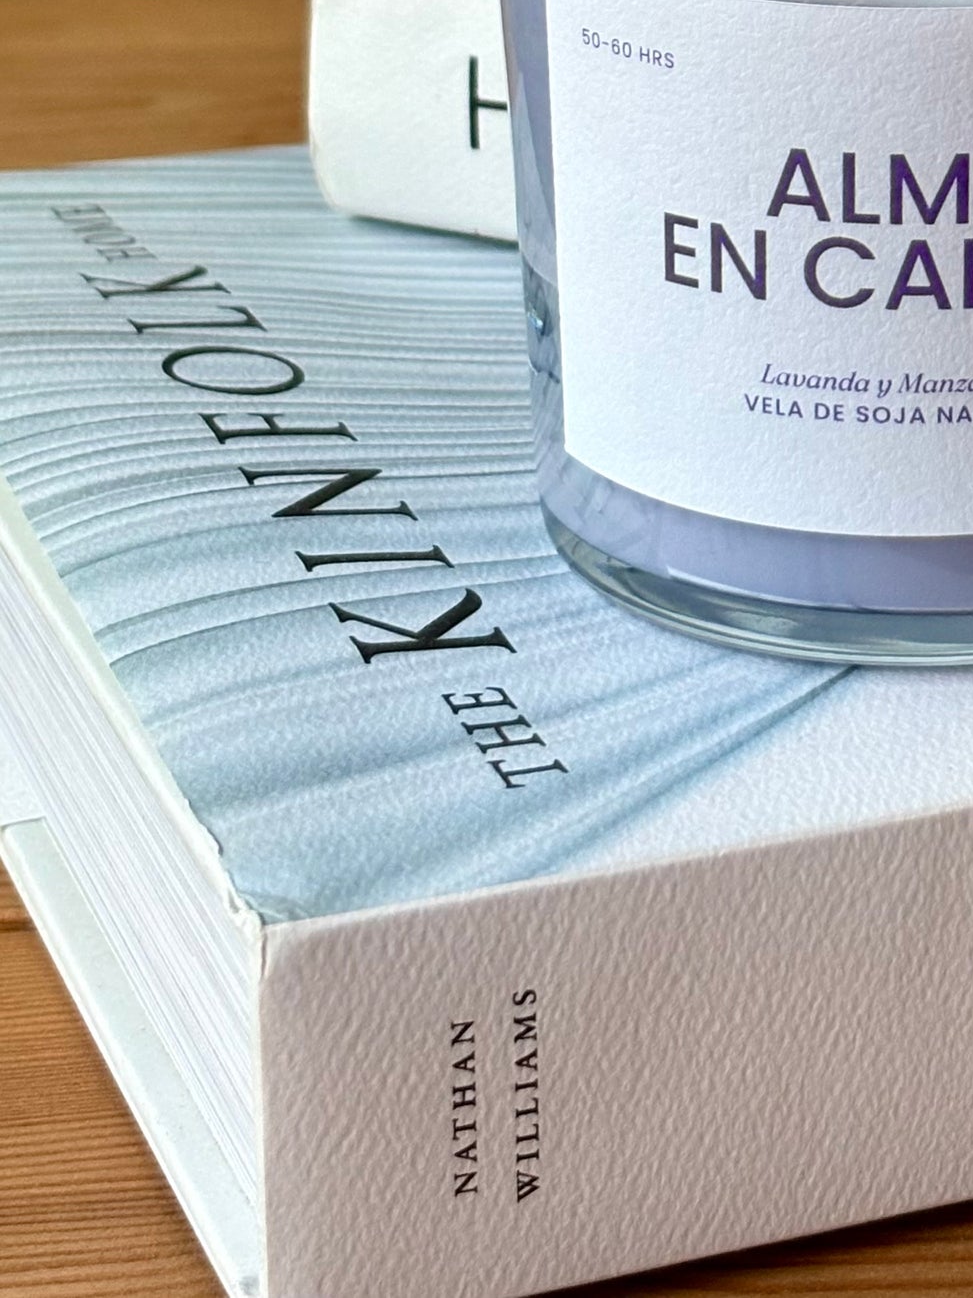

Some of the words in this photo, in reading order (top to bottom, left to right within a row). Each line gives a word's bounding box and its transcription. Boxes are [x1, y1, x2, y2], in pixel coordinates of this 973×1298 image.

[581, 27, 632, 59] 50-60
[639, 47, 675, 69] HRS
[663, 211, 768, 301] EN
[743, 394, 804, 419] VELA
[814, 402, 845, 423] DE
[856, 405, 926, 425] SOJA
[760, 363, 870, 394] Lavanda
[877, 379, 893, 399] y
[80, 264, 517, 665] KINFOLK
[440, 686, 569, 790] THE
[450, 1020, 478, 1197] NATHAN
[512, 988, 540, 1203] WILLIAMS
